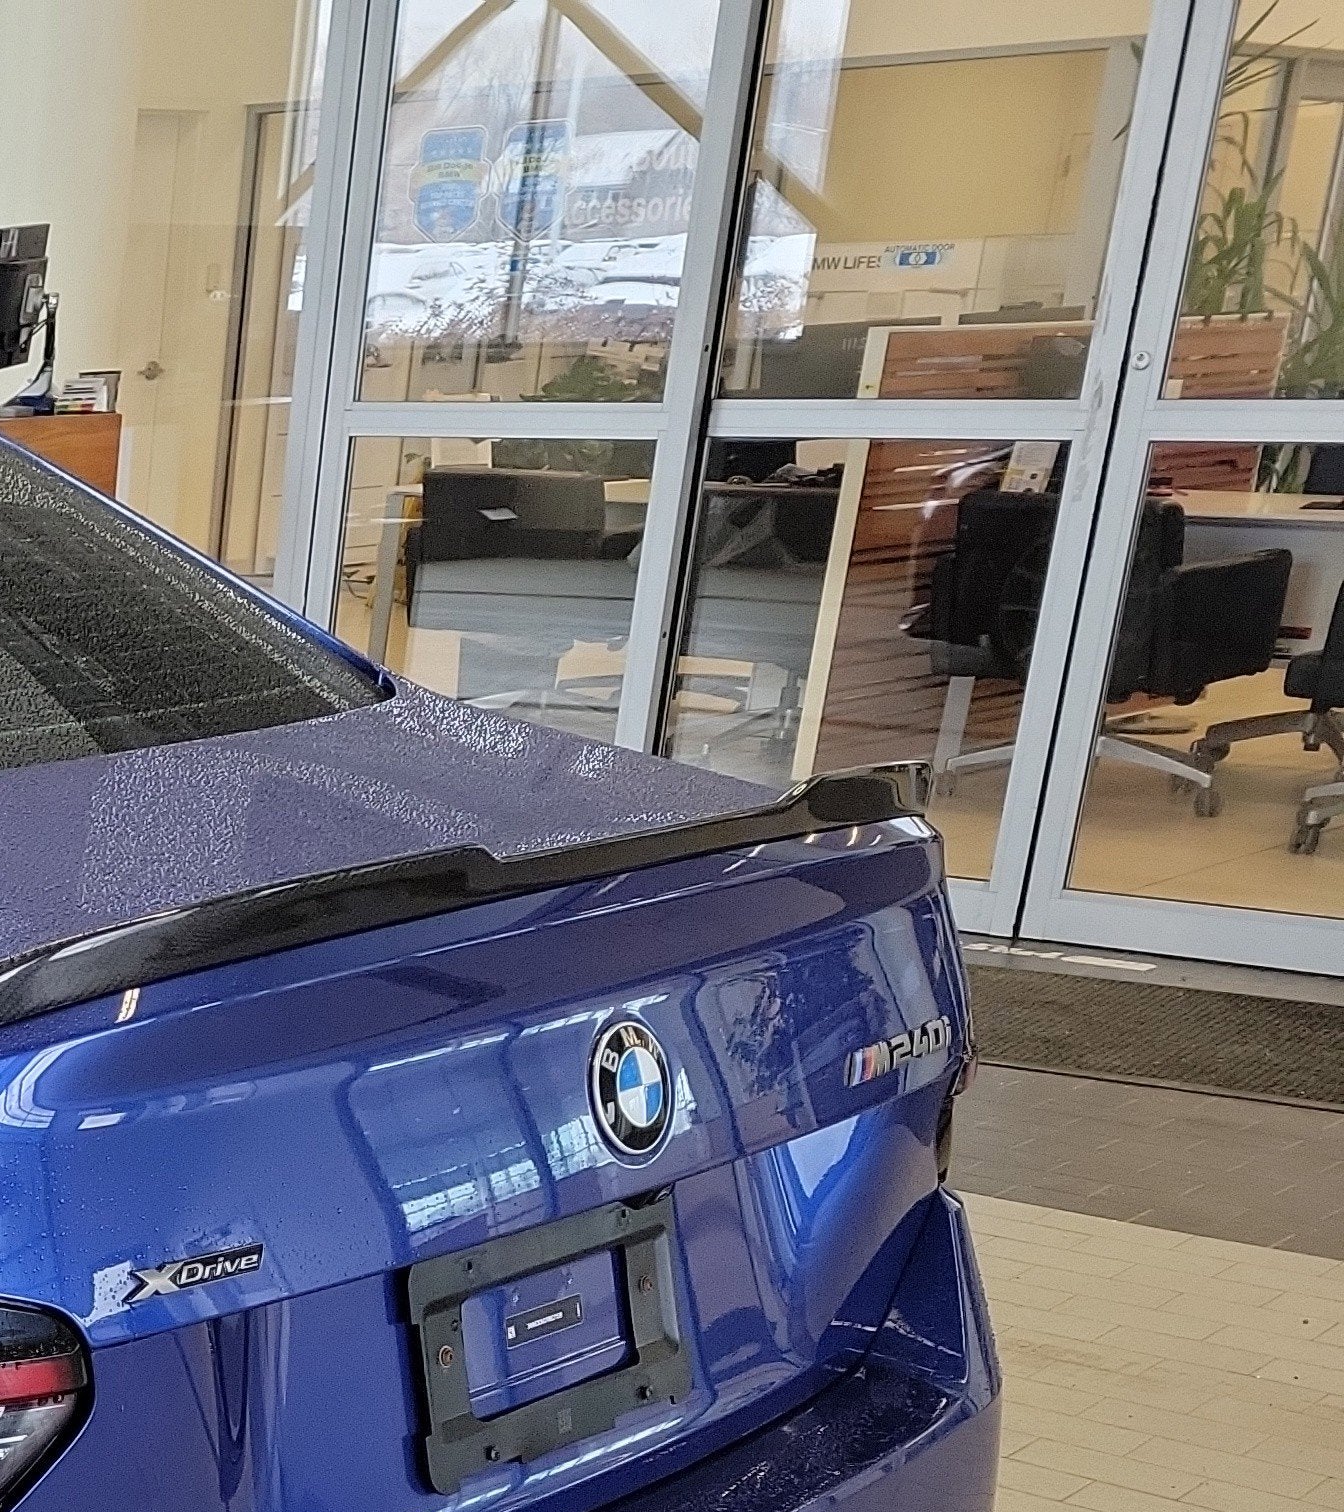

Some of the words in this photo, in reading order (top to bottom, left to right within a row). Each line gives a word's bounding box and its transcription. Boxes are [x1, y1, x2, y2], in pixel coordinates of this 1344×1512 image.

[812, 256, 842, 271] MW
[600, 1026, 660, 1073] BMW
[868, 1014, 952, 1079] M240i
